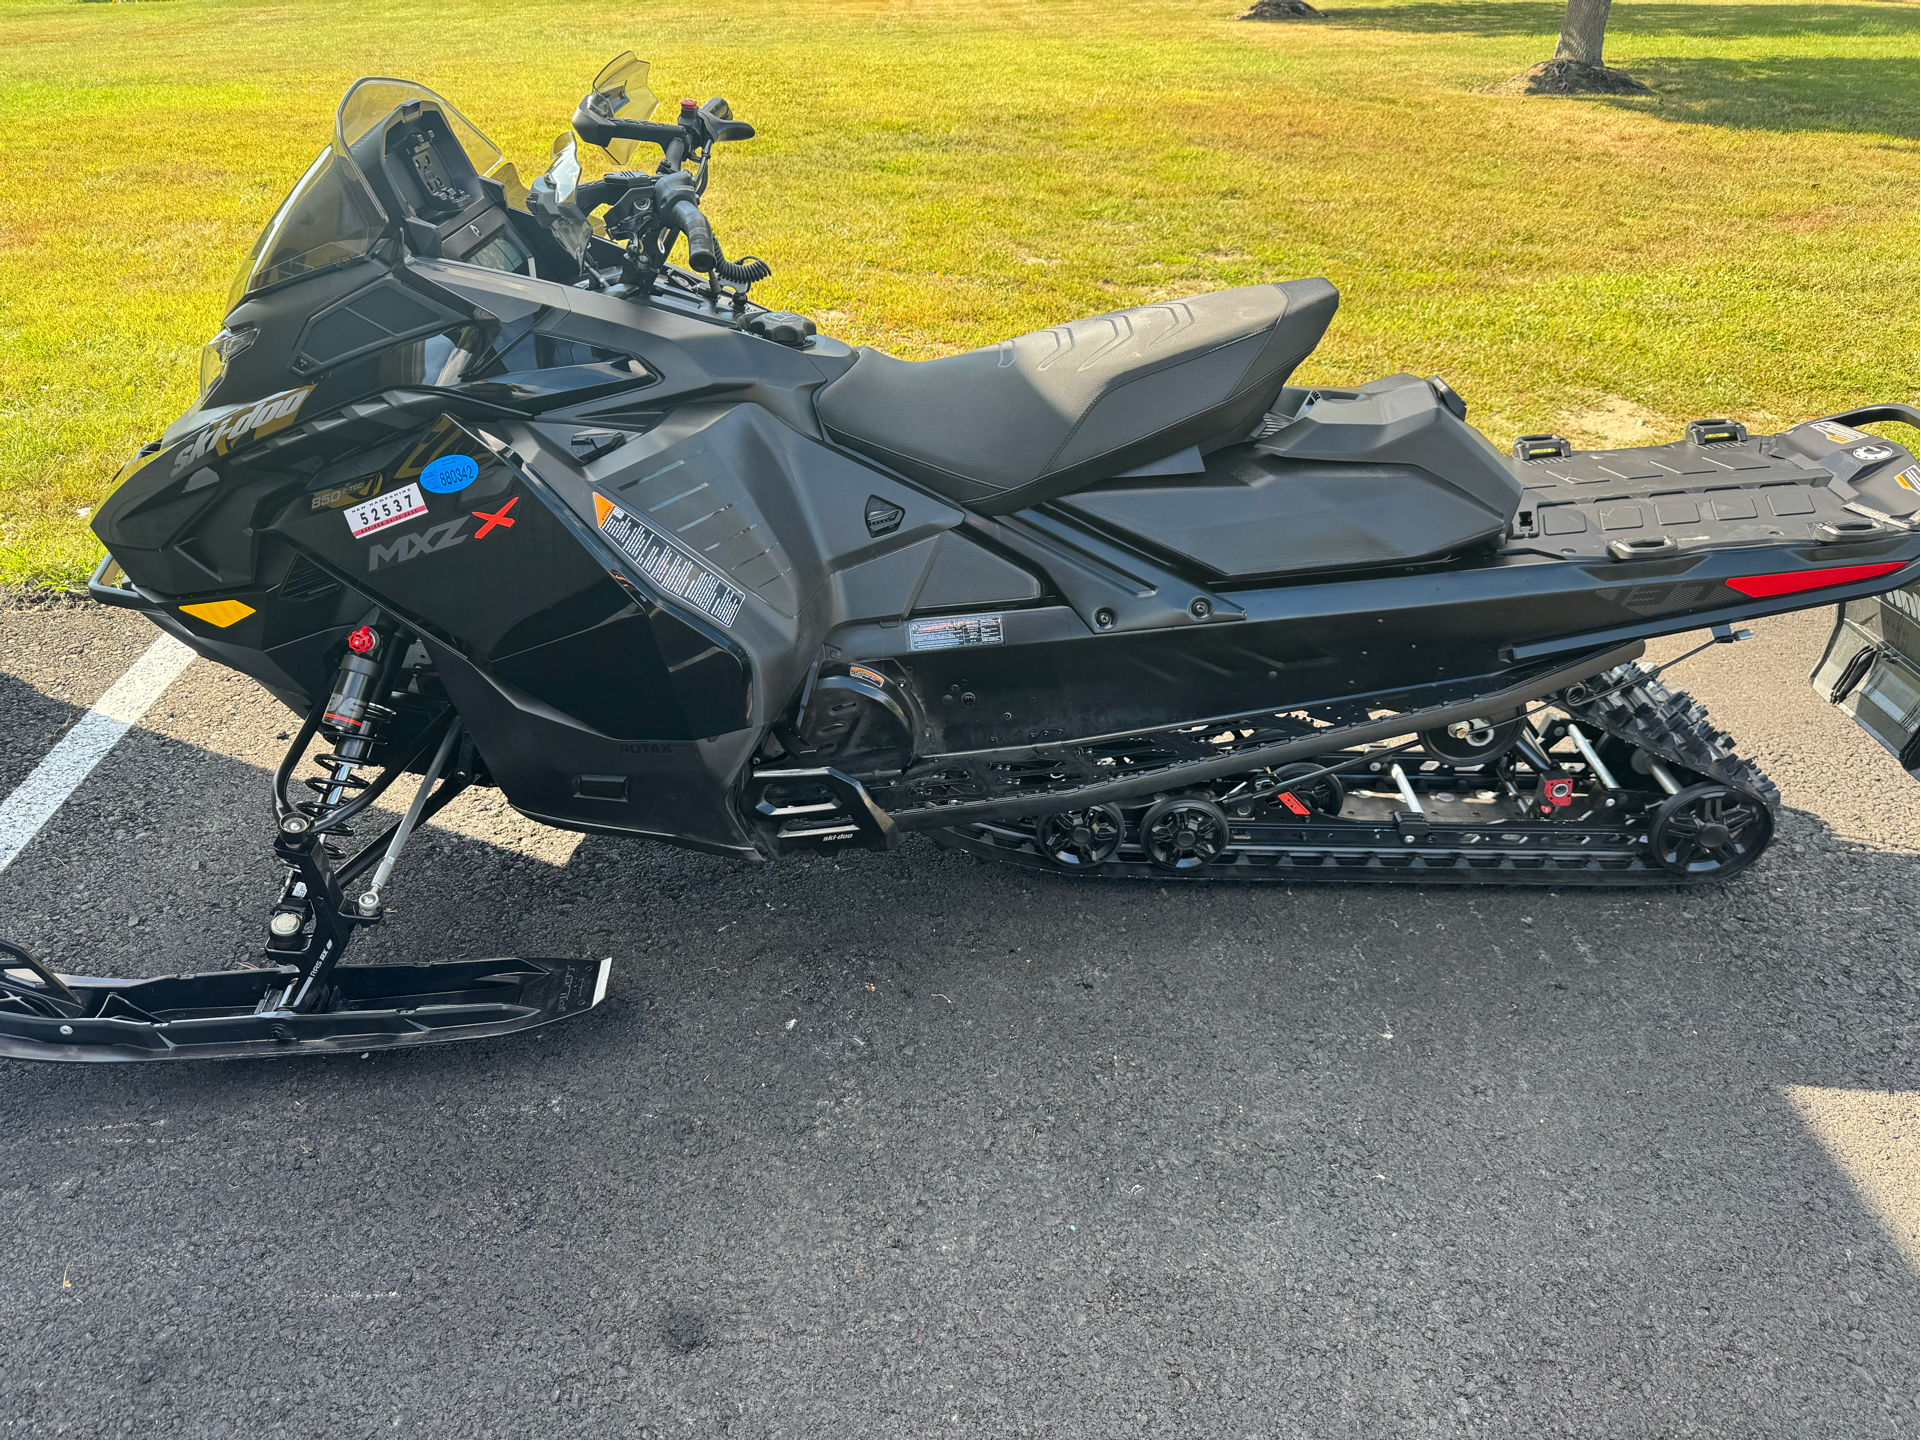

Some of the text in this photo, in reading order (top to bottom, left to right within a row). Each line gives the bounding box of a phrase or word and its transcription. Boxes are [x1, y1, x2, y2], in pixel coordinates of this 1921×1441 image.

[169, 388, 310, 478] ski-doo
[439, 464, 475, 487] 880342
[311, 489, 342, 510] 850
[351, 487, 412, 514] NEW HAMPSHIRE
[359, 493, 414, 526] 52537
[368, 496, 520, 573] MXZ X
[619, 743, 675, 754] ROTAX
